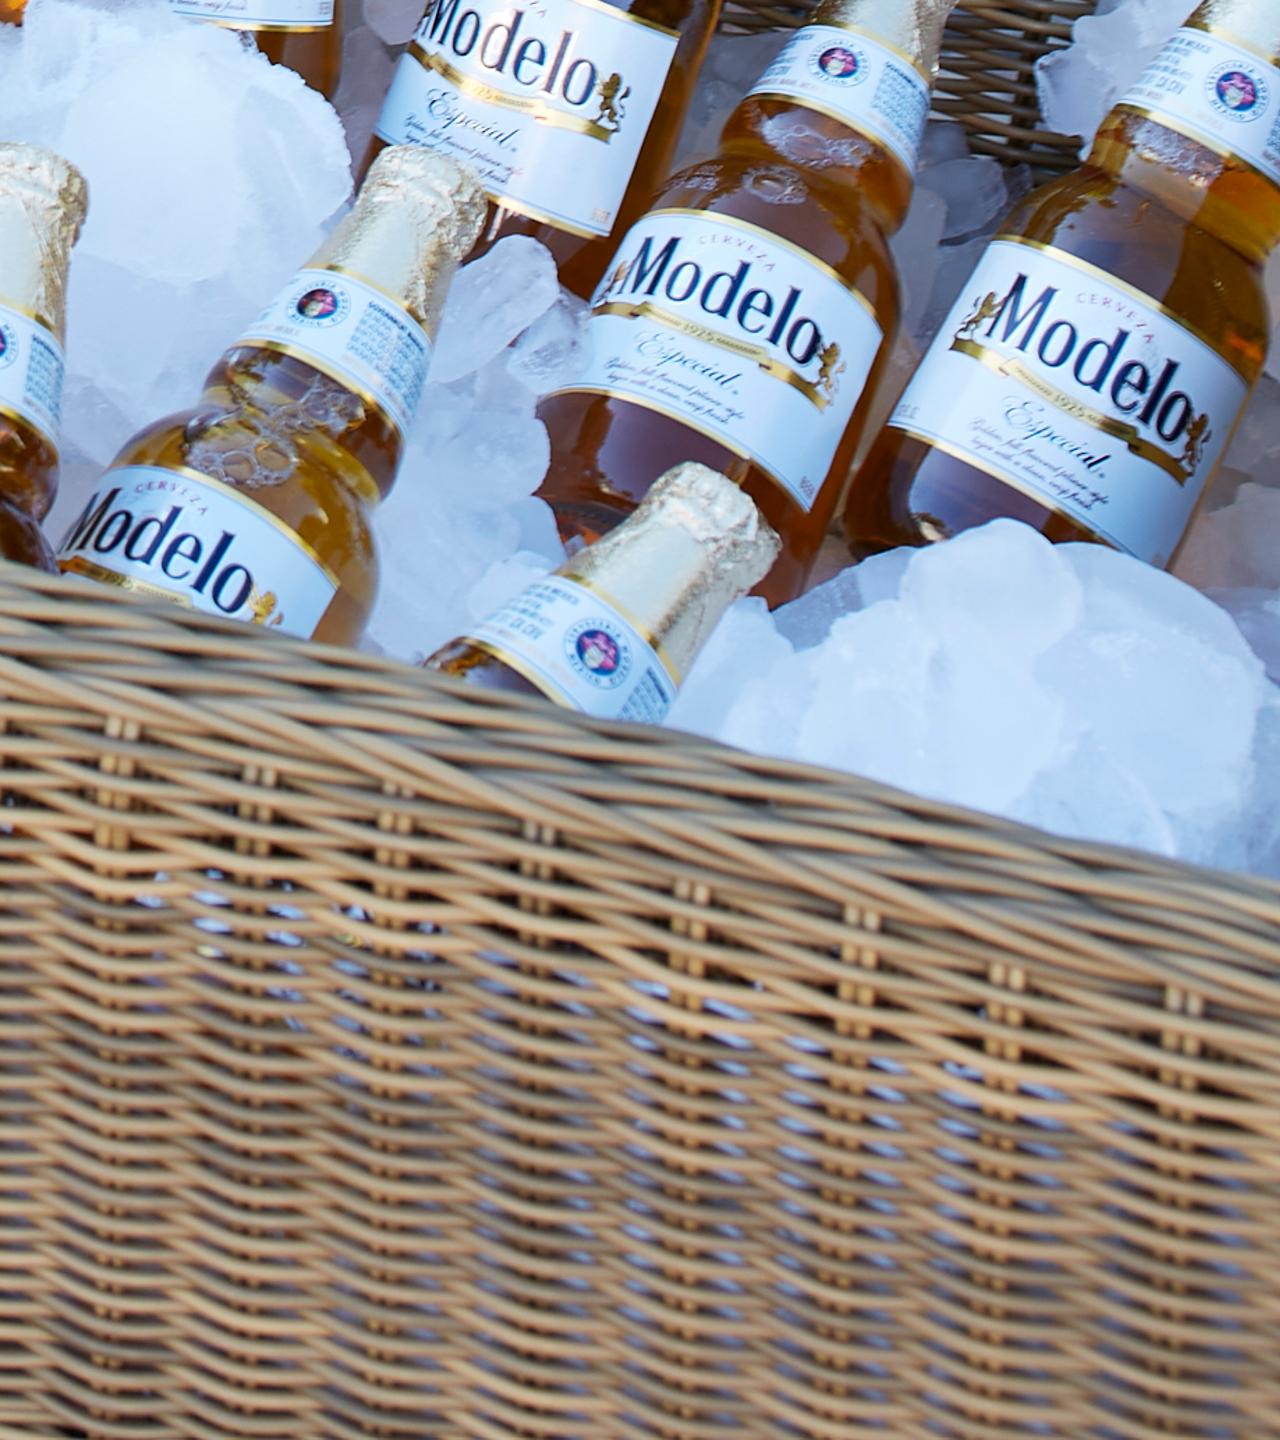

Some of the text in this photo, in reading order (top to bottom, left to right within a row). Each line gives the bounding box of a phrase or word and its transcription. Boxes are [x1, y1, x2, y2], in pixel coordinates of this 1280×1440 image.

[426, 87, 521, 150] Especial
[698, 234, 776, 273] CERVEZA
[616, 236, 821, 365] Modelo
[1076, 291, 1155, 345] CERVEZA
[634, 331, 743, 392] Especial
[984, 273, 1194, 443] Modelo
[1002, 395, 1111, 472] Especial
[135, 480, 209, 516] CERVEZA
[58, 487, 254, 614] Modelo
